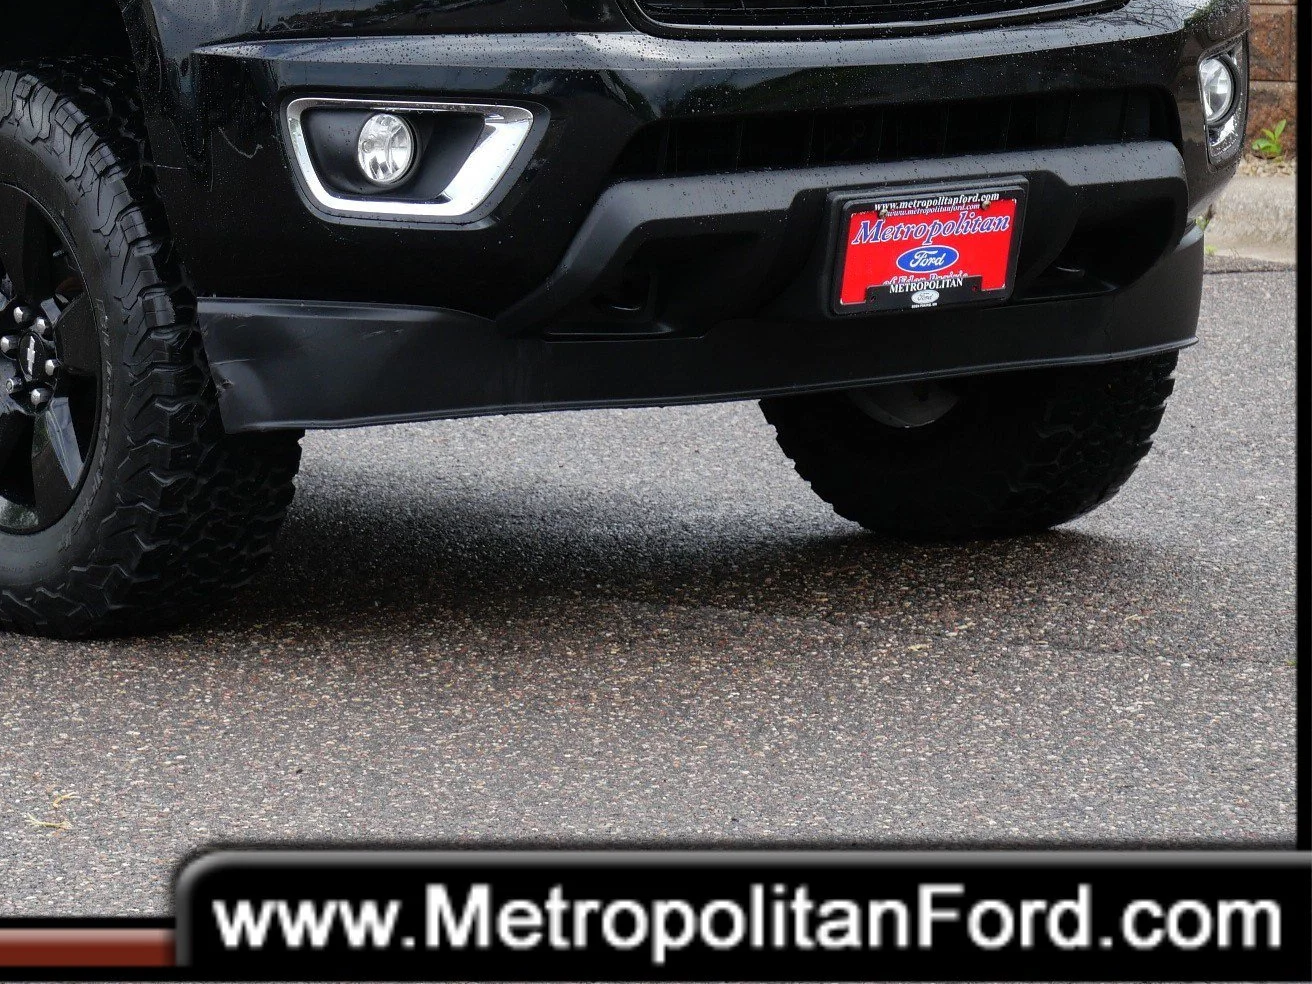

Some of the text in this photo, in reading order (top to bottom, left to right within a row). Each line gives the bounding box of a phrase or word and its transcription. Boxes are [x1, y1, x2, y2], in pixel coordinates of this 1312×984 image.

[851, 211, 1010, 245] Metropolitan
[909, 250, 945, 267] Ford
[889, 277, 964, 294] METROPOLITAN
